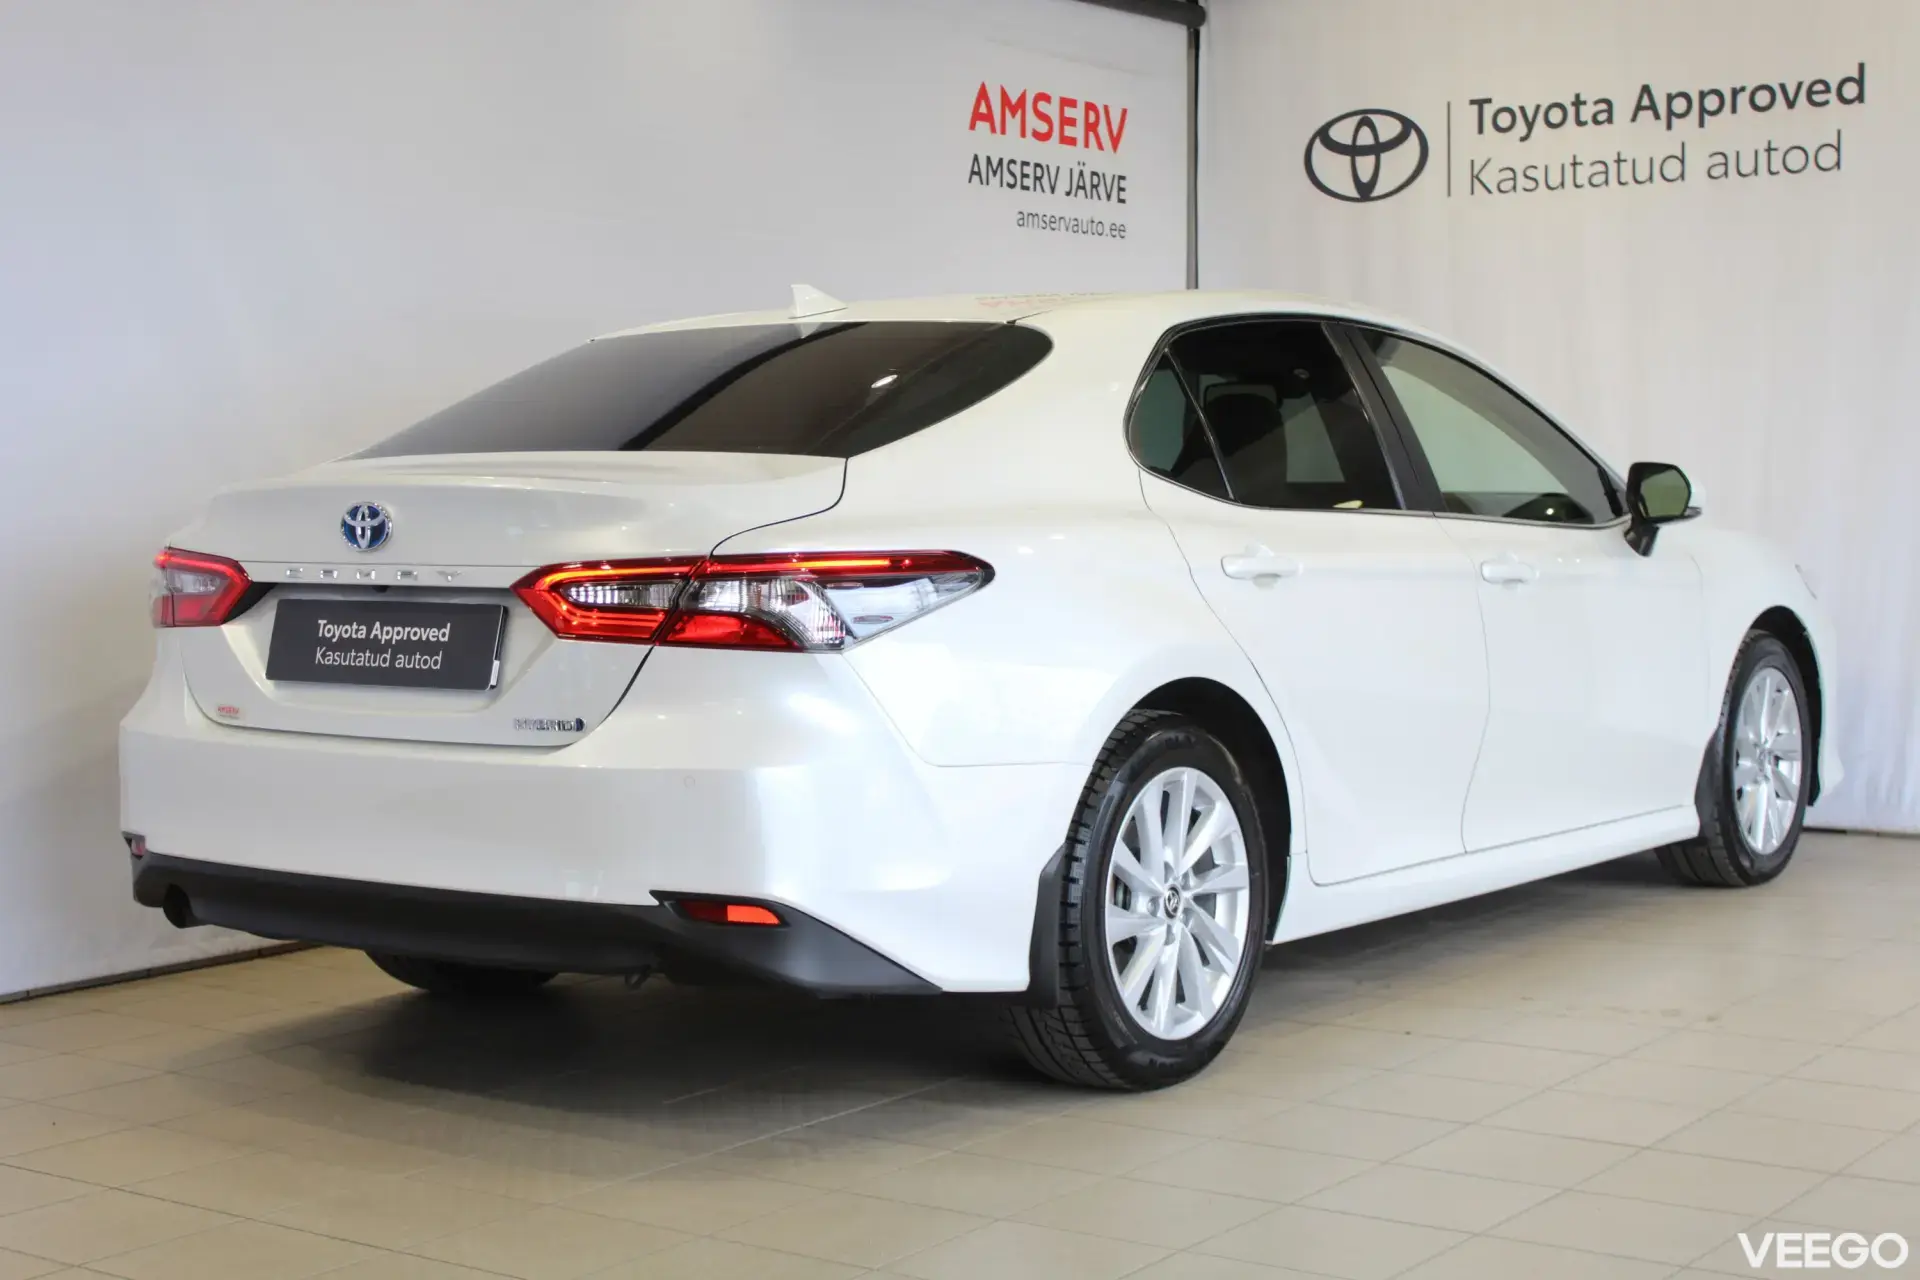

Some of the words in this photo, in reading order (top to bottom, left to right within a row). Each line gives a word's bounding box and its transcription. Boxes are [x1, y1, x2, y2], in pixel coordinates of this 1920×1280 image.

[967, 81, 1129, 154] AMSERV
[1468, 90, 1615, 143] Toyota
[1630, 61, 1867, 131] Approved
[967, 153, 1061, 195] AMSERV
[1064, 160, 1128, 205] JÄRVE
[1469, 140, 1686, 196] Kasutatud
[1705, 128, 1843, 181] autod
[1016, 210, 1127, 240] amservauto.ee
[315, 646, 391, 668] Kasutatud
[394, 651, 443, 670] autod
[317, 619, 367, 643] Toyota
[369, 620, 451, 645] Approved
